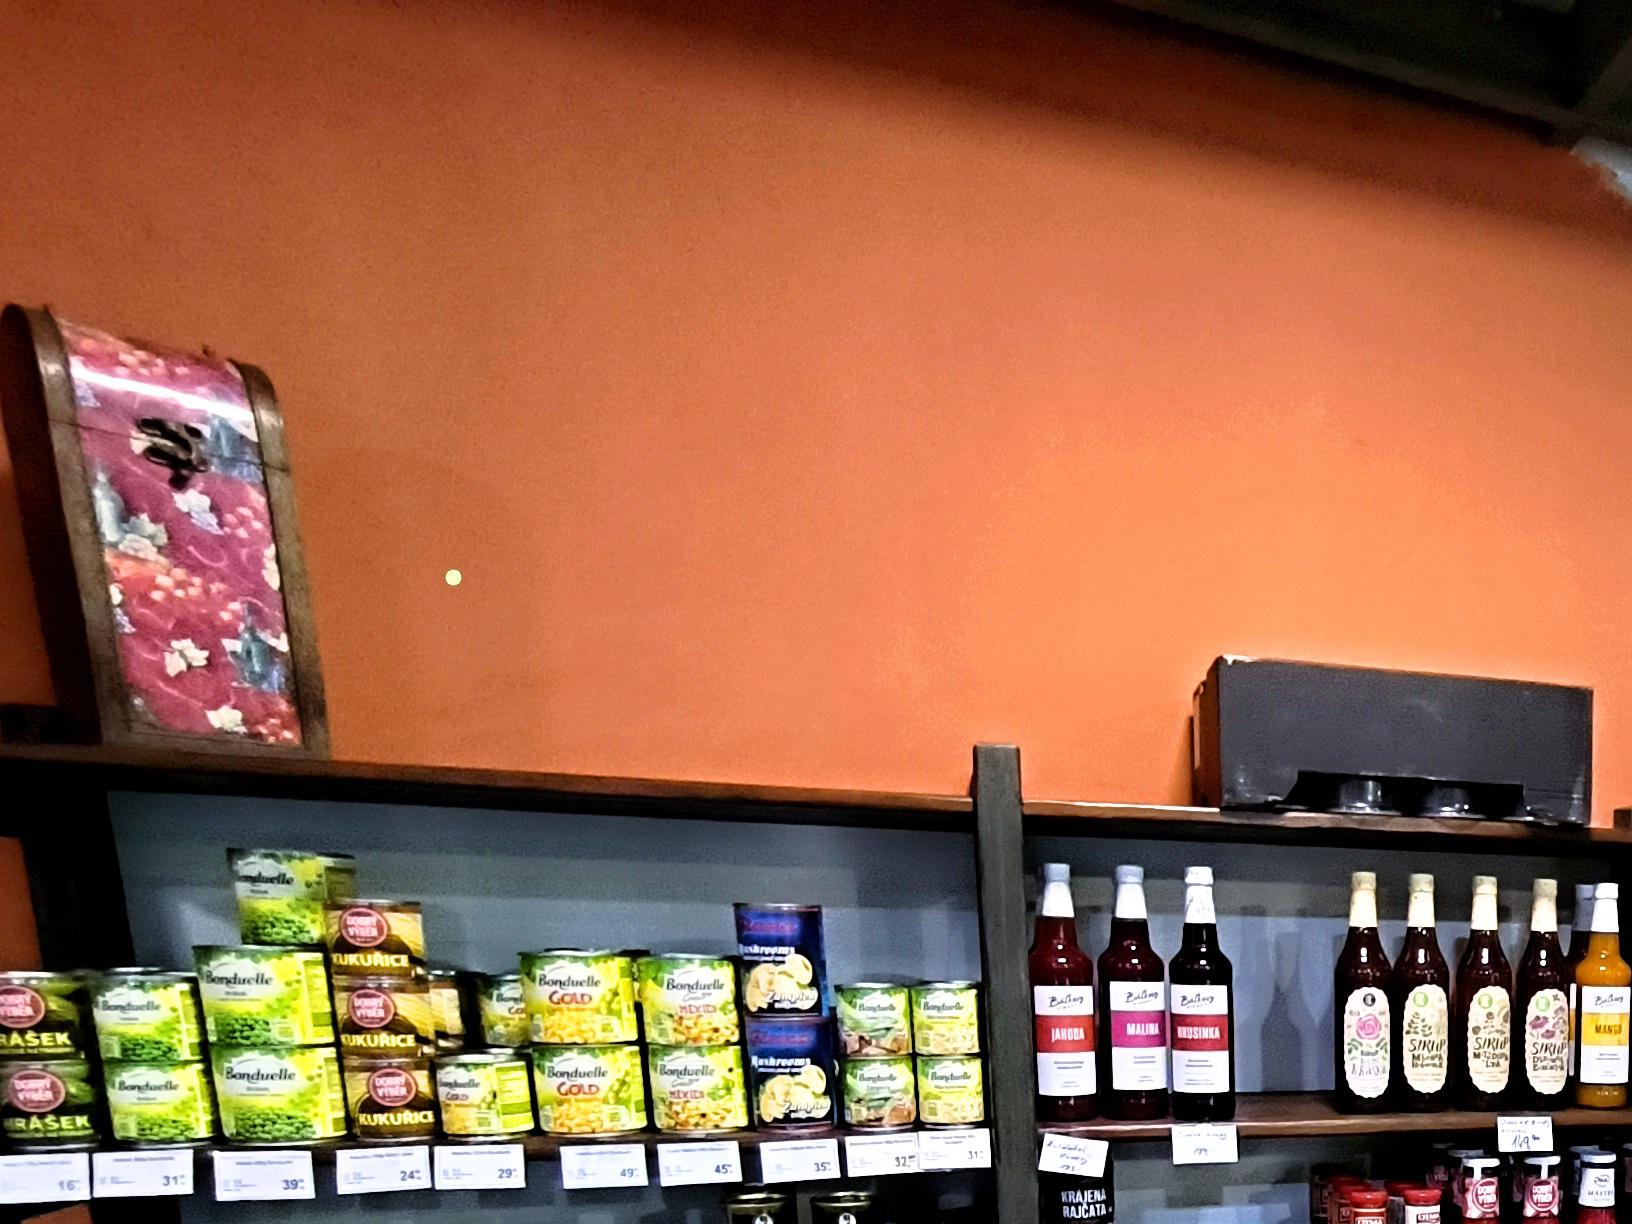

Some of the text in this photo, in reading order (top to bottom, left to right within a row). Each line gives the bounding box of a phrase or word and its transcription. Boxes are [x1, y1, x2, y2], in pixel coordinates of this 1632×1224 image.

[538, 973, 602, 990] Bonduelle
[665, 977, 725, 992] Bonduelle
[0, 1029, 72, 1047] RÁŠEK
[225, 1066, 297, 1084] Bonduelle
[546, 1065, 609, 1082] Bonduelle
[358, 1107, 436, 1126] KUKUŘICE
[1060, 1186, 1107, 1204] KRÁJENÁ
[1062, 1201, 1107, 1219] RAJČATA
